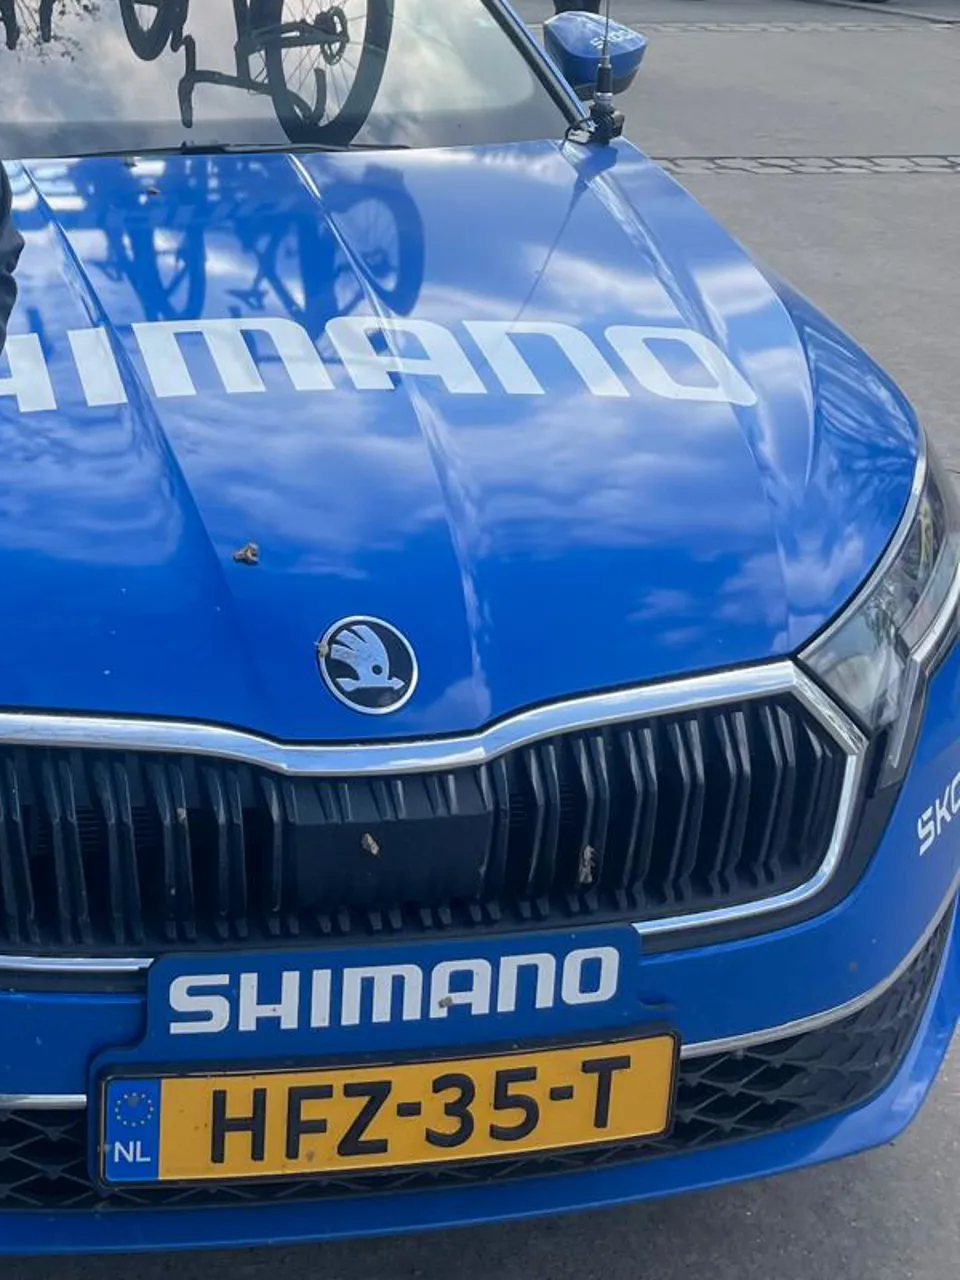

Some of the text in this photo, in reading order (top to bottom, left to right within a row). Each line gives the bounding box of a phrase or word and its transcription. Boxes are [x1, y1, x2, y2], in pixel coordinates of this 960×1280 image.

[167, 945, 621, 1035] SHIMANO
[114, 1140, 151, 1164] NL
[210, 1055, 632, 1165] HFZ-35-T
